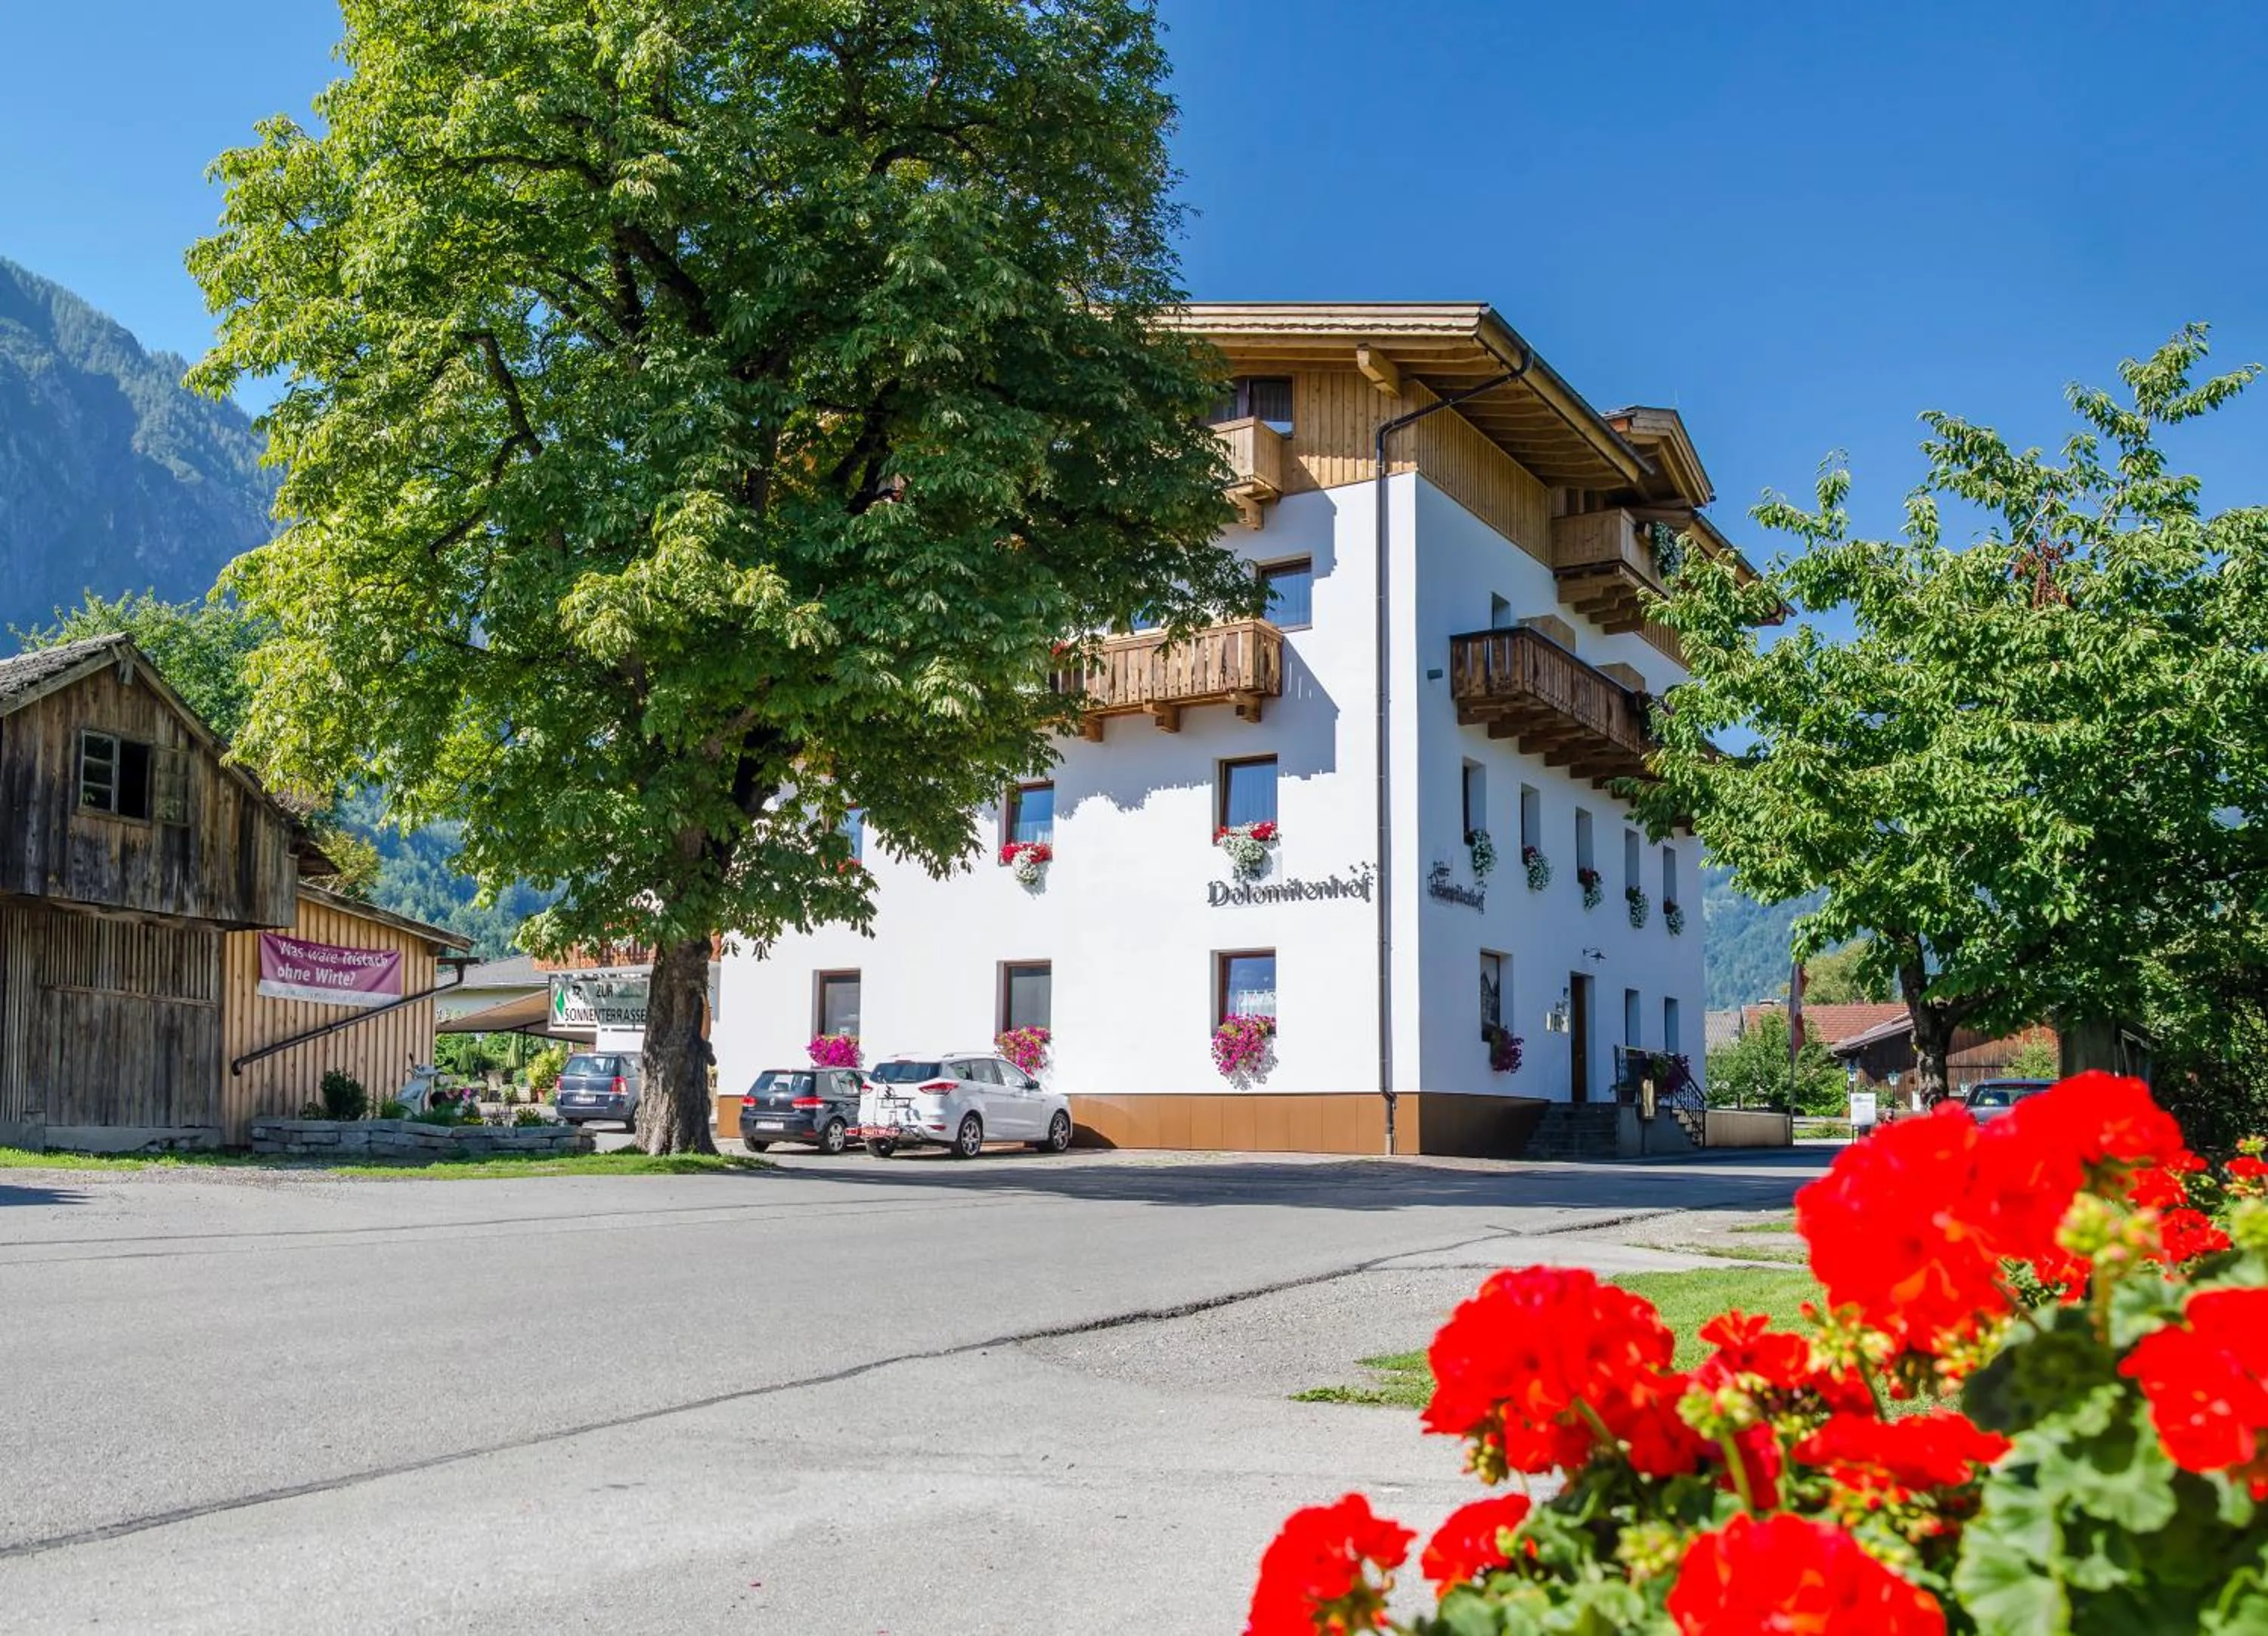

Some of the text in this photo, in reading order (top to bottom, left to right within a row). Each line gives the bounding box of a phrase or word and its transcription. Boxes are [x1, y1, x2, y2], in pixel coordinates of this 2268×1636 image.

[1207, 873, 1374, 907] Dolomitenhof
[278, 940, 303, 959] Was
[308, 949, 339, 964] wäre
[277, 962, 356, 987] ohne Wirte?
[565, 1008, 646, 1022] SONNENTERRASSE
